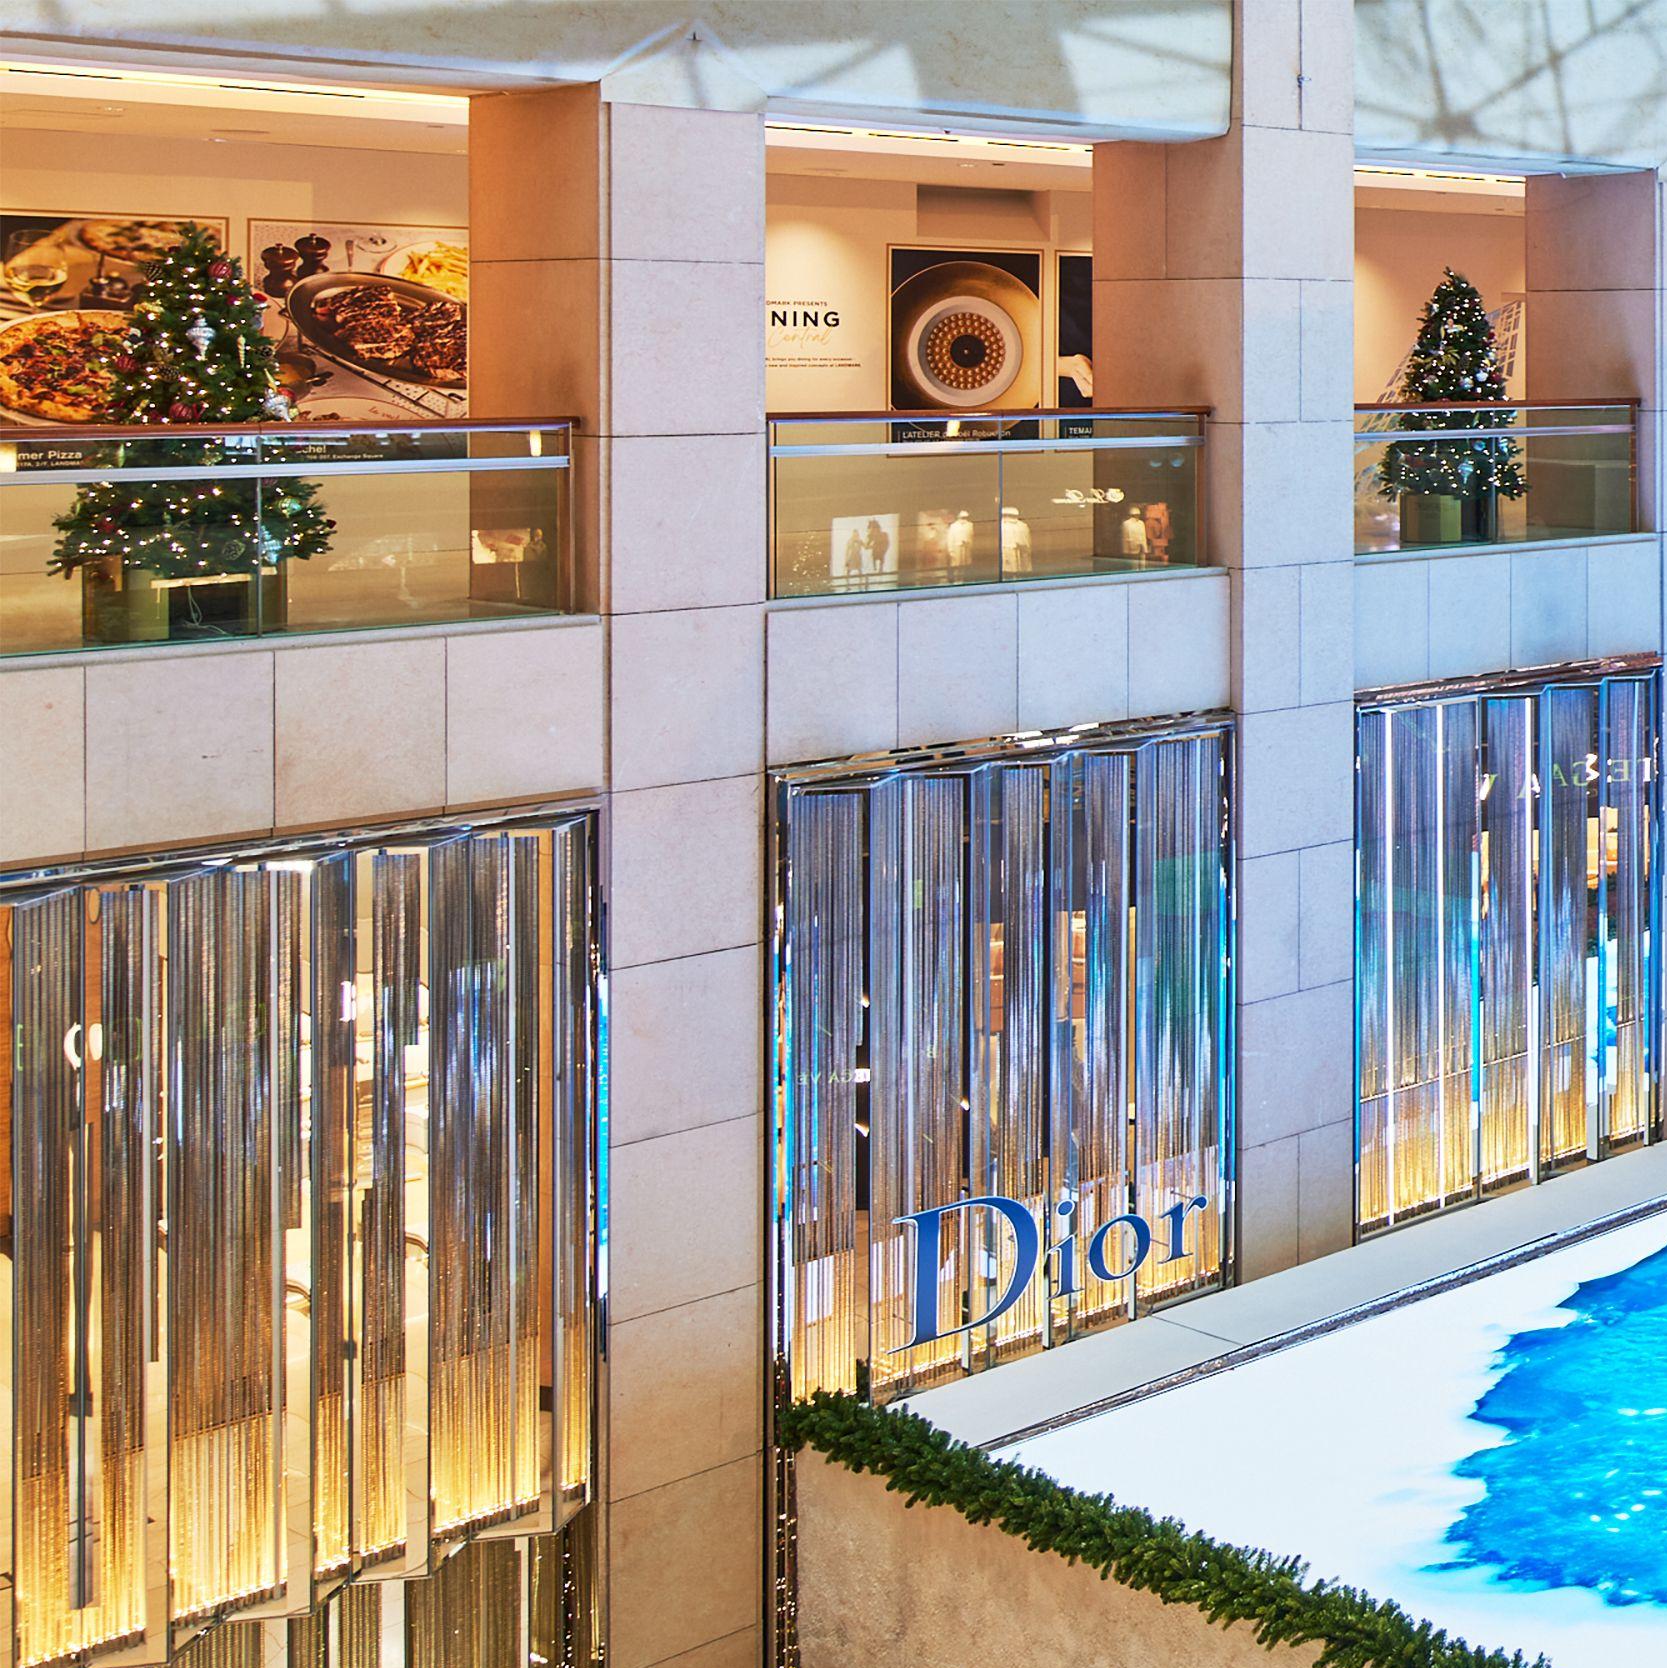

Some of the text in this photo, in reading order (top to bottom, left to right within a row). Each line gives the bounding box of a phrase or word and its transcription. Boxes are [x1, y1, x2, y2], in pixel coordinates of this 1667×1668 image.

[771, 311, 840, 328] NING
[48, 451, 83, 460] Pizza
[887, 1194, 1209, 1354] Dior
